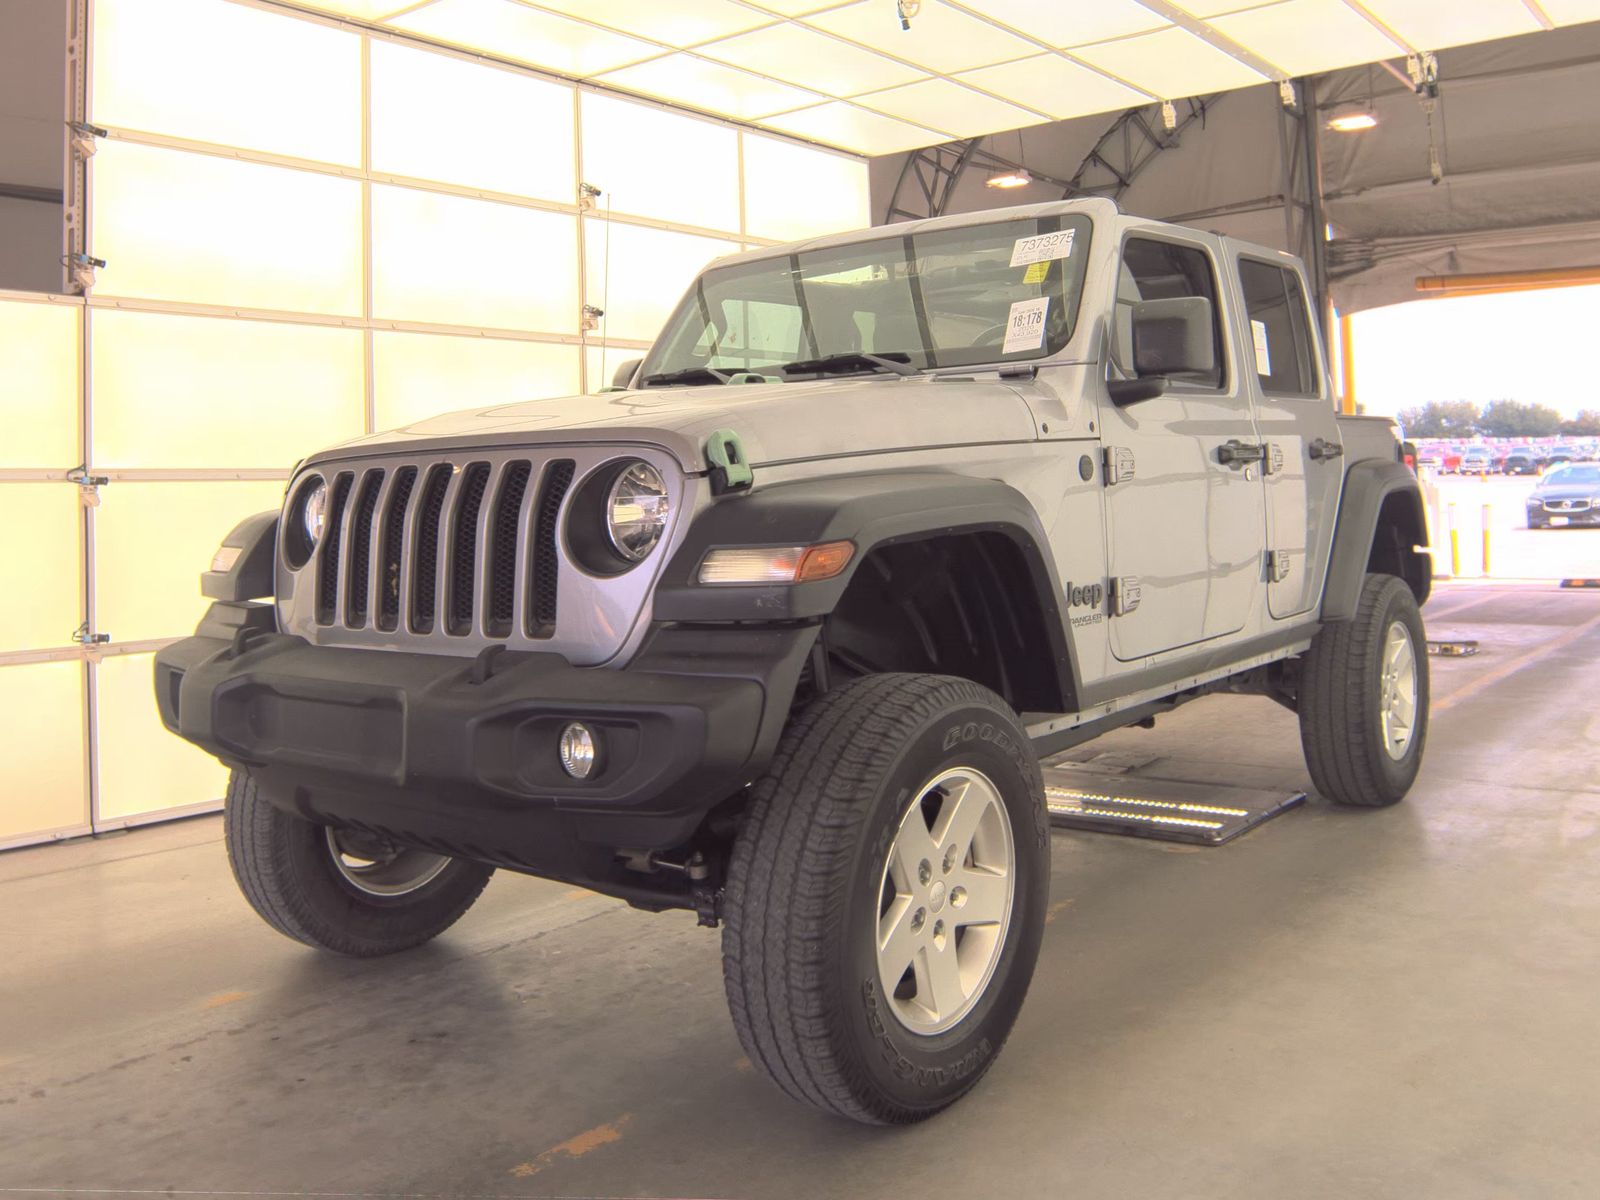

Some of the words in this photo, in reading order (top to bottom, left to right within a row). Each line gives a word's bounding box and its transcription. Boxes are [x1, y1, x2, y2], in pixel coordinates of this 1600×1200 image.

[1021, 232, 1073, 251] 7373275
[1013, 311, 1043, 328] 18:178
[1066, 581, 1103, 609] Jeep
